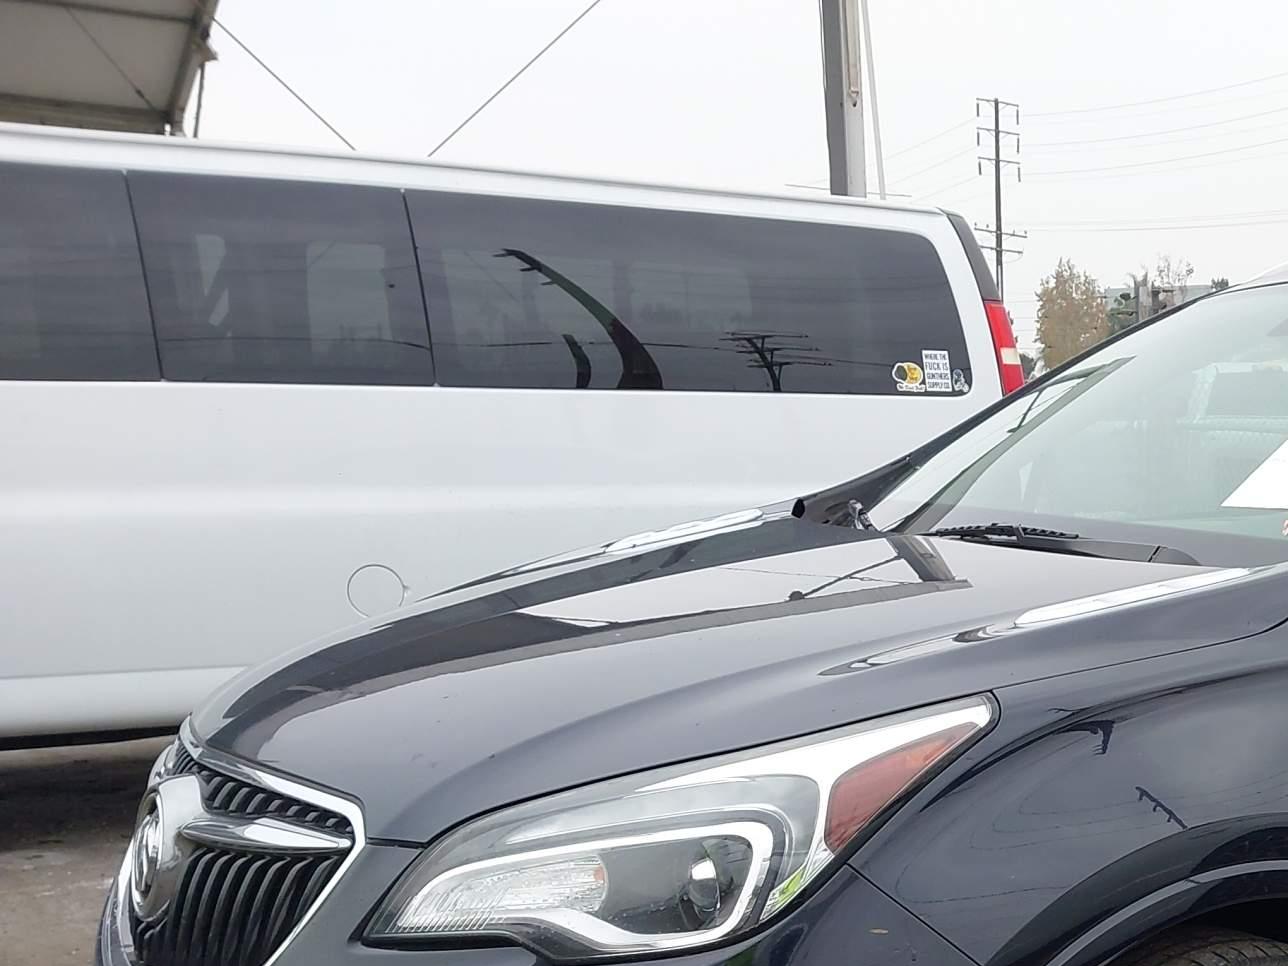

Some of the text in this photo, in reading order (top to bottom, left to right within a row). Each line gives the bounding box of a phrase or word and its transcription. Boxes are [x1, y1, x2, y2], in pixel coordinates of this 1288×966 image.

[939, 353, 947, 361] THE
[925, 362, 949, 371] FUCK IS
[927, 381, 943, 389] SUPPLY
